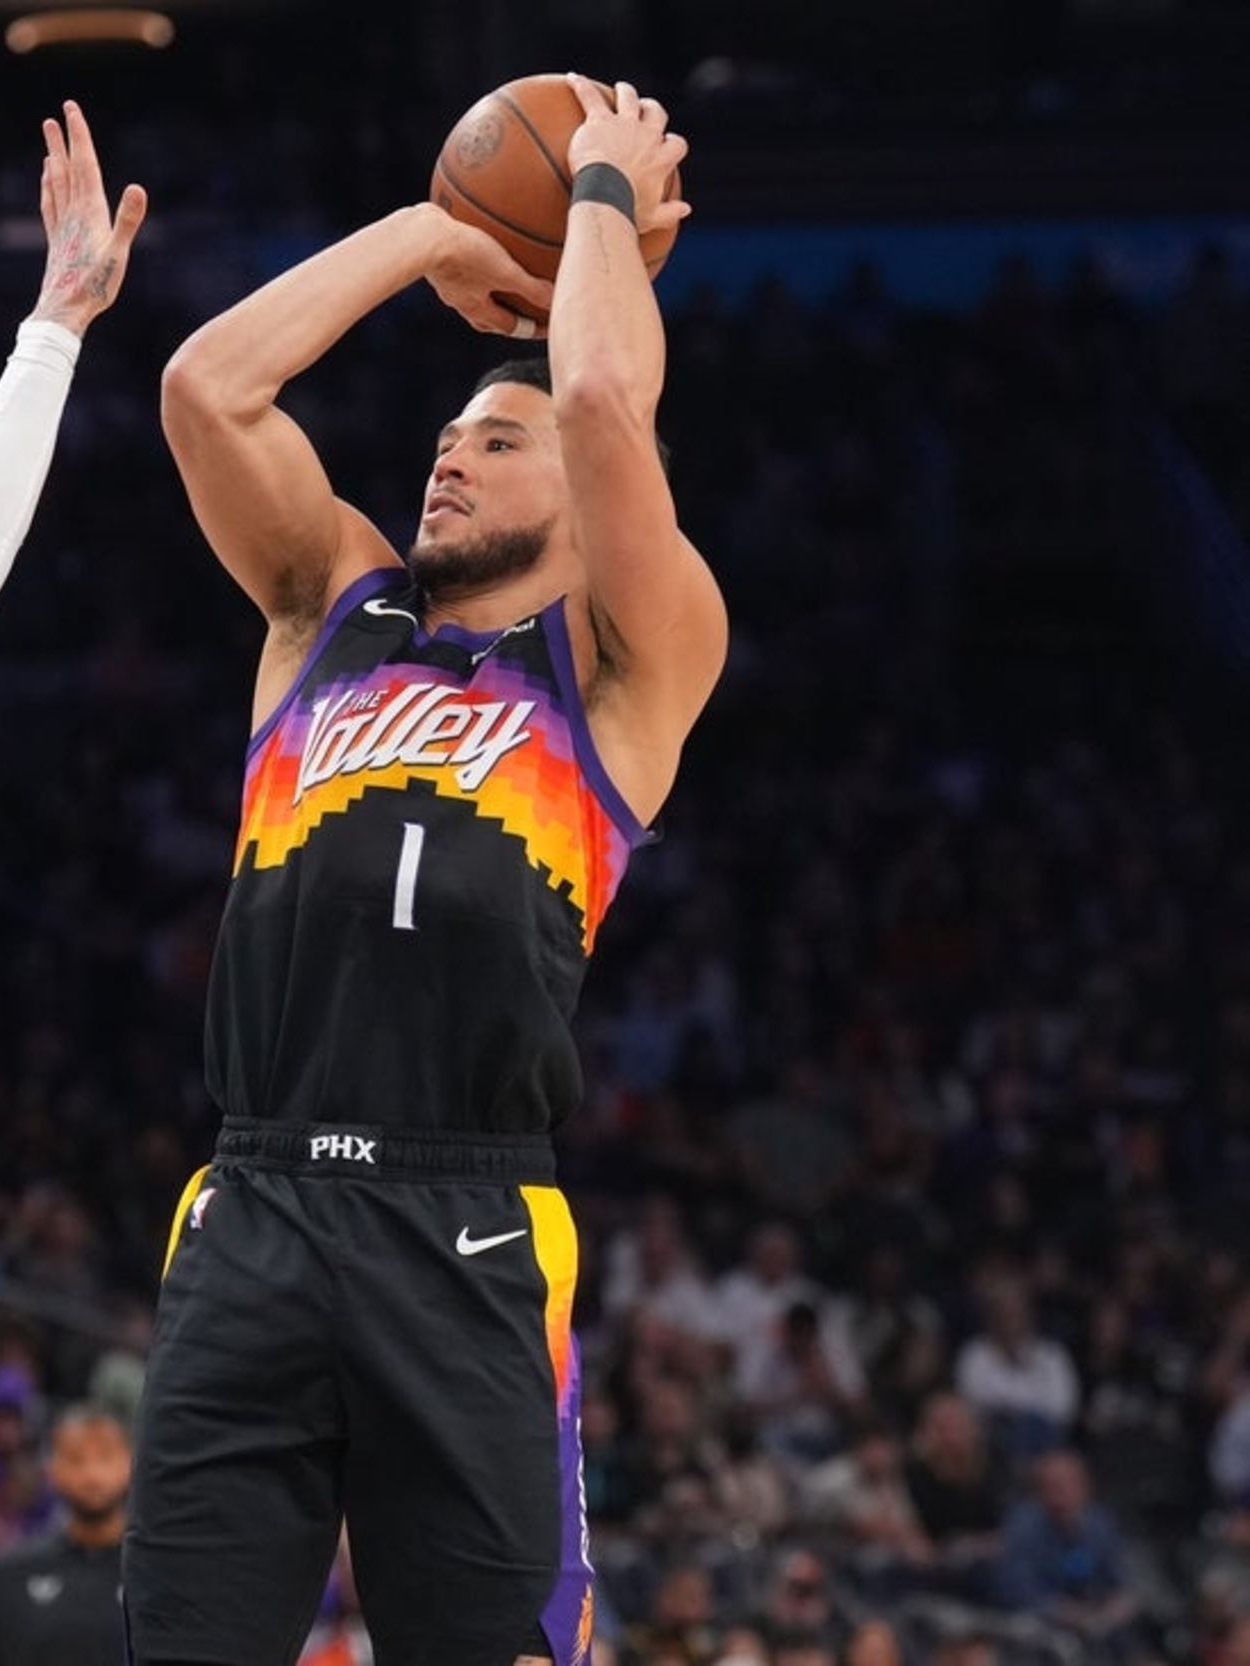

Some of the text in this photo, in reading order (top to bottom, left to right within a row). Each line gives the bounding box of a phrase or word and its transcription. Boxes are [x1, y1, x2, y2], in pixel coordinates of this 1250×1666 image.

[291, 683, 537, 808] Valley
[393, 822, 425, 930] 1
[310, 1134, 376, 1165] PHX
